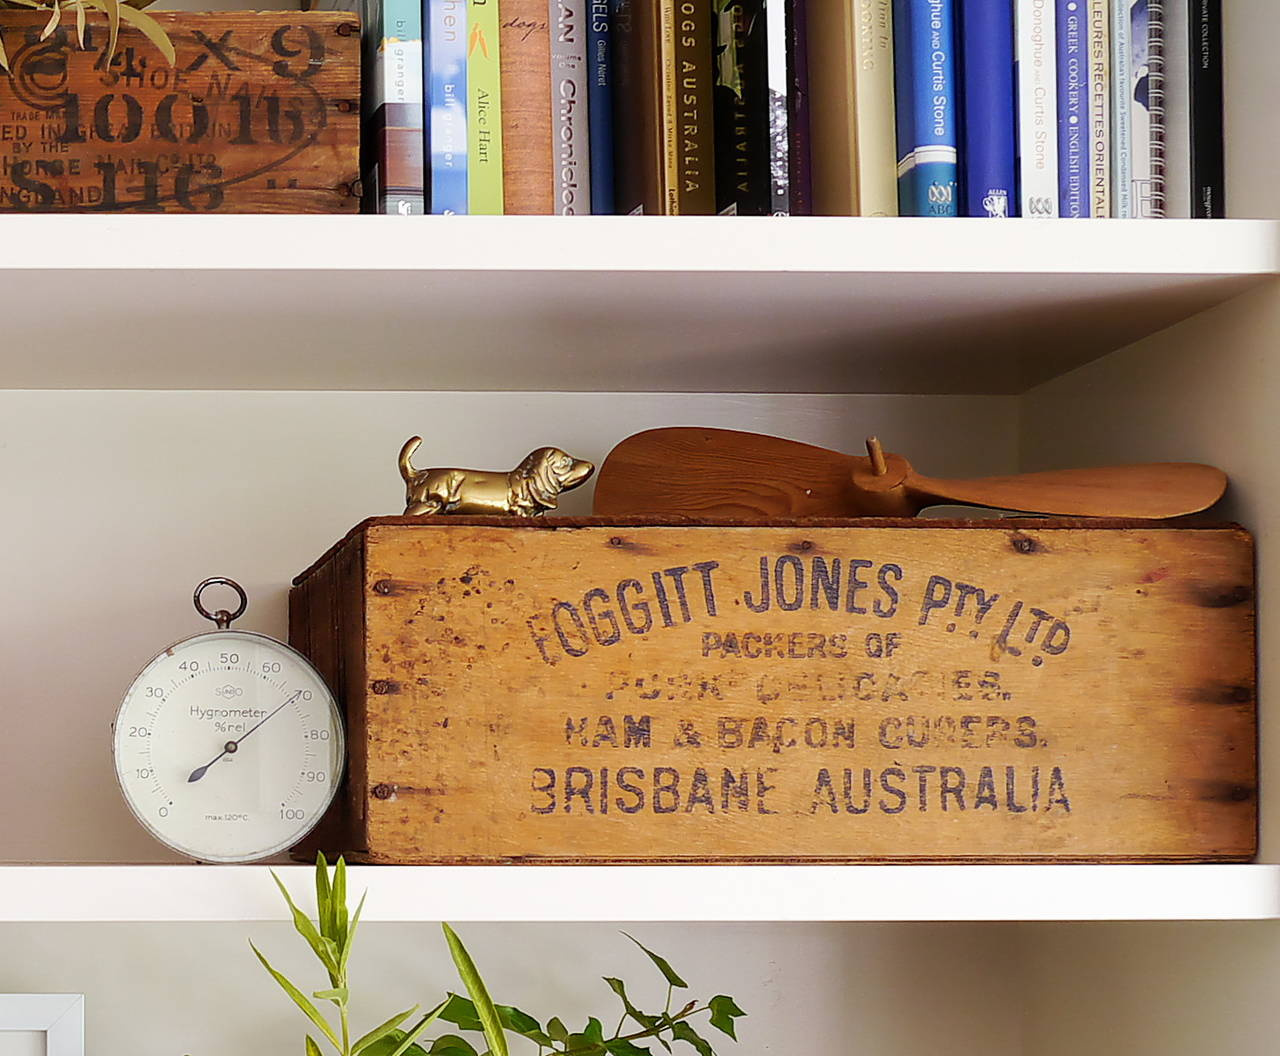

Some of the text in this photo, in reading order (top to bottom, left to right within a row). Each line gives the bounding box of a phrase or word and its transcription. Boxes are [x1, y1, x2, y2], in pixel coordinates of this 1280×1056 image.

[502, 16, 547, 42] dogs
[557, 0, 576, 43] AN
[1067, 15, 1079, 54] GREEK
[271, 25, 325, 78] 9
[930, 30, 940, 49] AND
[1201, 23, 1210, 69] COLLECTION
[393, 48, 406, 103] granger
[931, 50, 946, 91] Curtis
[1067, 58, 1081, 115] COOKERY
[443, 83, 457, 107] bill
[1034, 86, 1047, 126] Curtis
[1093, 62, 1105, 139] RECETTES
[477, 87, 492, 165] Alice Hart
[932, 95, 947, 136] Stone
[1119, 111, 1130, 150] Sweetened
[12, 142, 70, 154] BY THE
[1034, 130, 1048, 170] Stone
[1068, 126, 1080, 173] ENGLISH
[1120, 151, 1130, 192] Condensed
[1121, 193, 1131, 209] Milk
[526, 560, 720, 667] FOGGITT
[743, 554, 903, 618] JONES
[219, 652, 240, 665] 50
[701, 631, 903, 659] PACKERS OF
[178, 660, 200, 672] 40
[261, 661, 282, 674] 60
[145, 686, 164, 698] 30
[189, 705, 268, 720] Hygrometer
[128, 726, 148, 738] 20
[309, 729, 330, 742] 80
[674, 718, 702, 748] &
[717, 715, 856, 750] BACON
[135, 767, 150, 780] 10
[306, 770, 326, 783] 90
[530, 765, 1072, 815] BRISBANE AUSTRALIA
[158, 806, 169, 818] 0
[279, 808, 306, 821] 100
